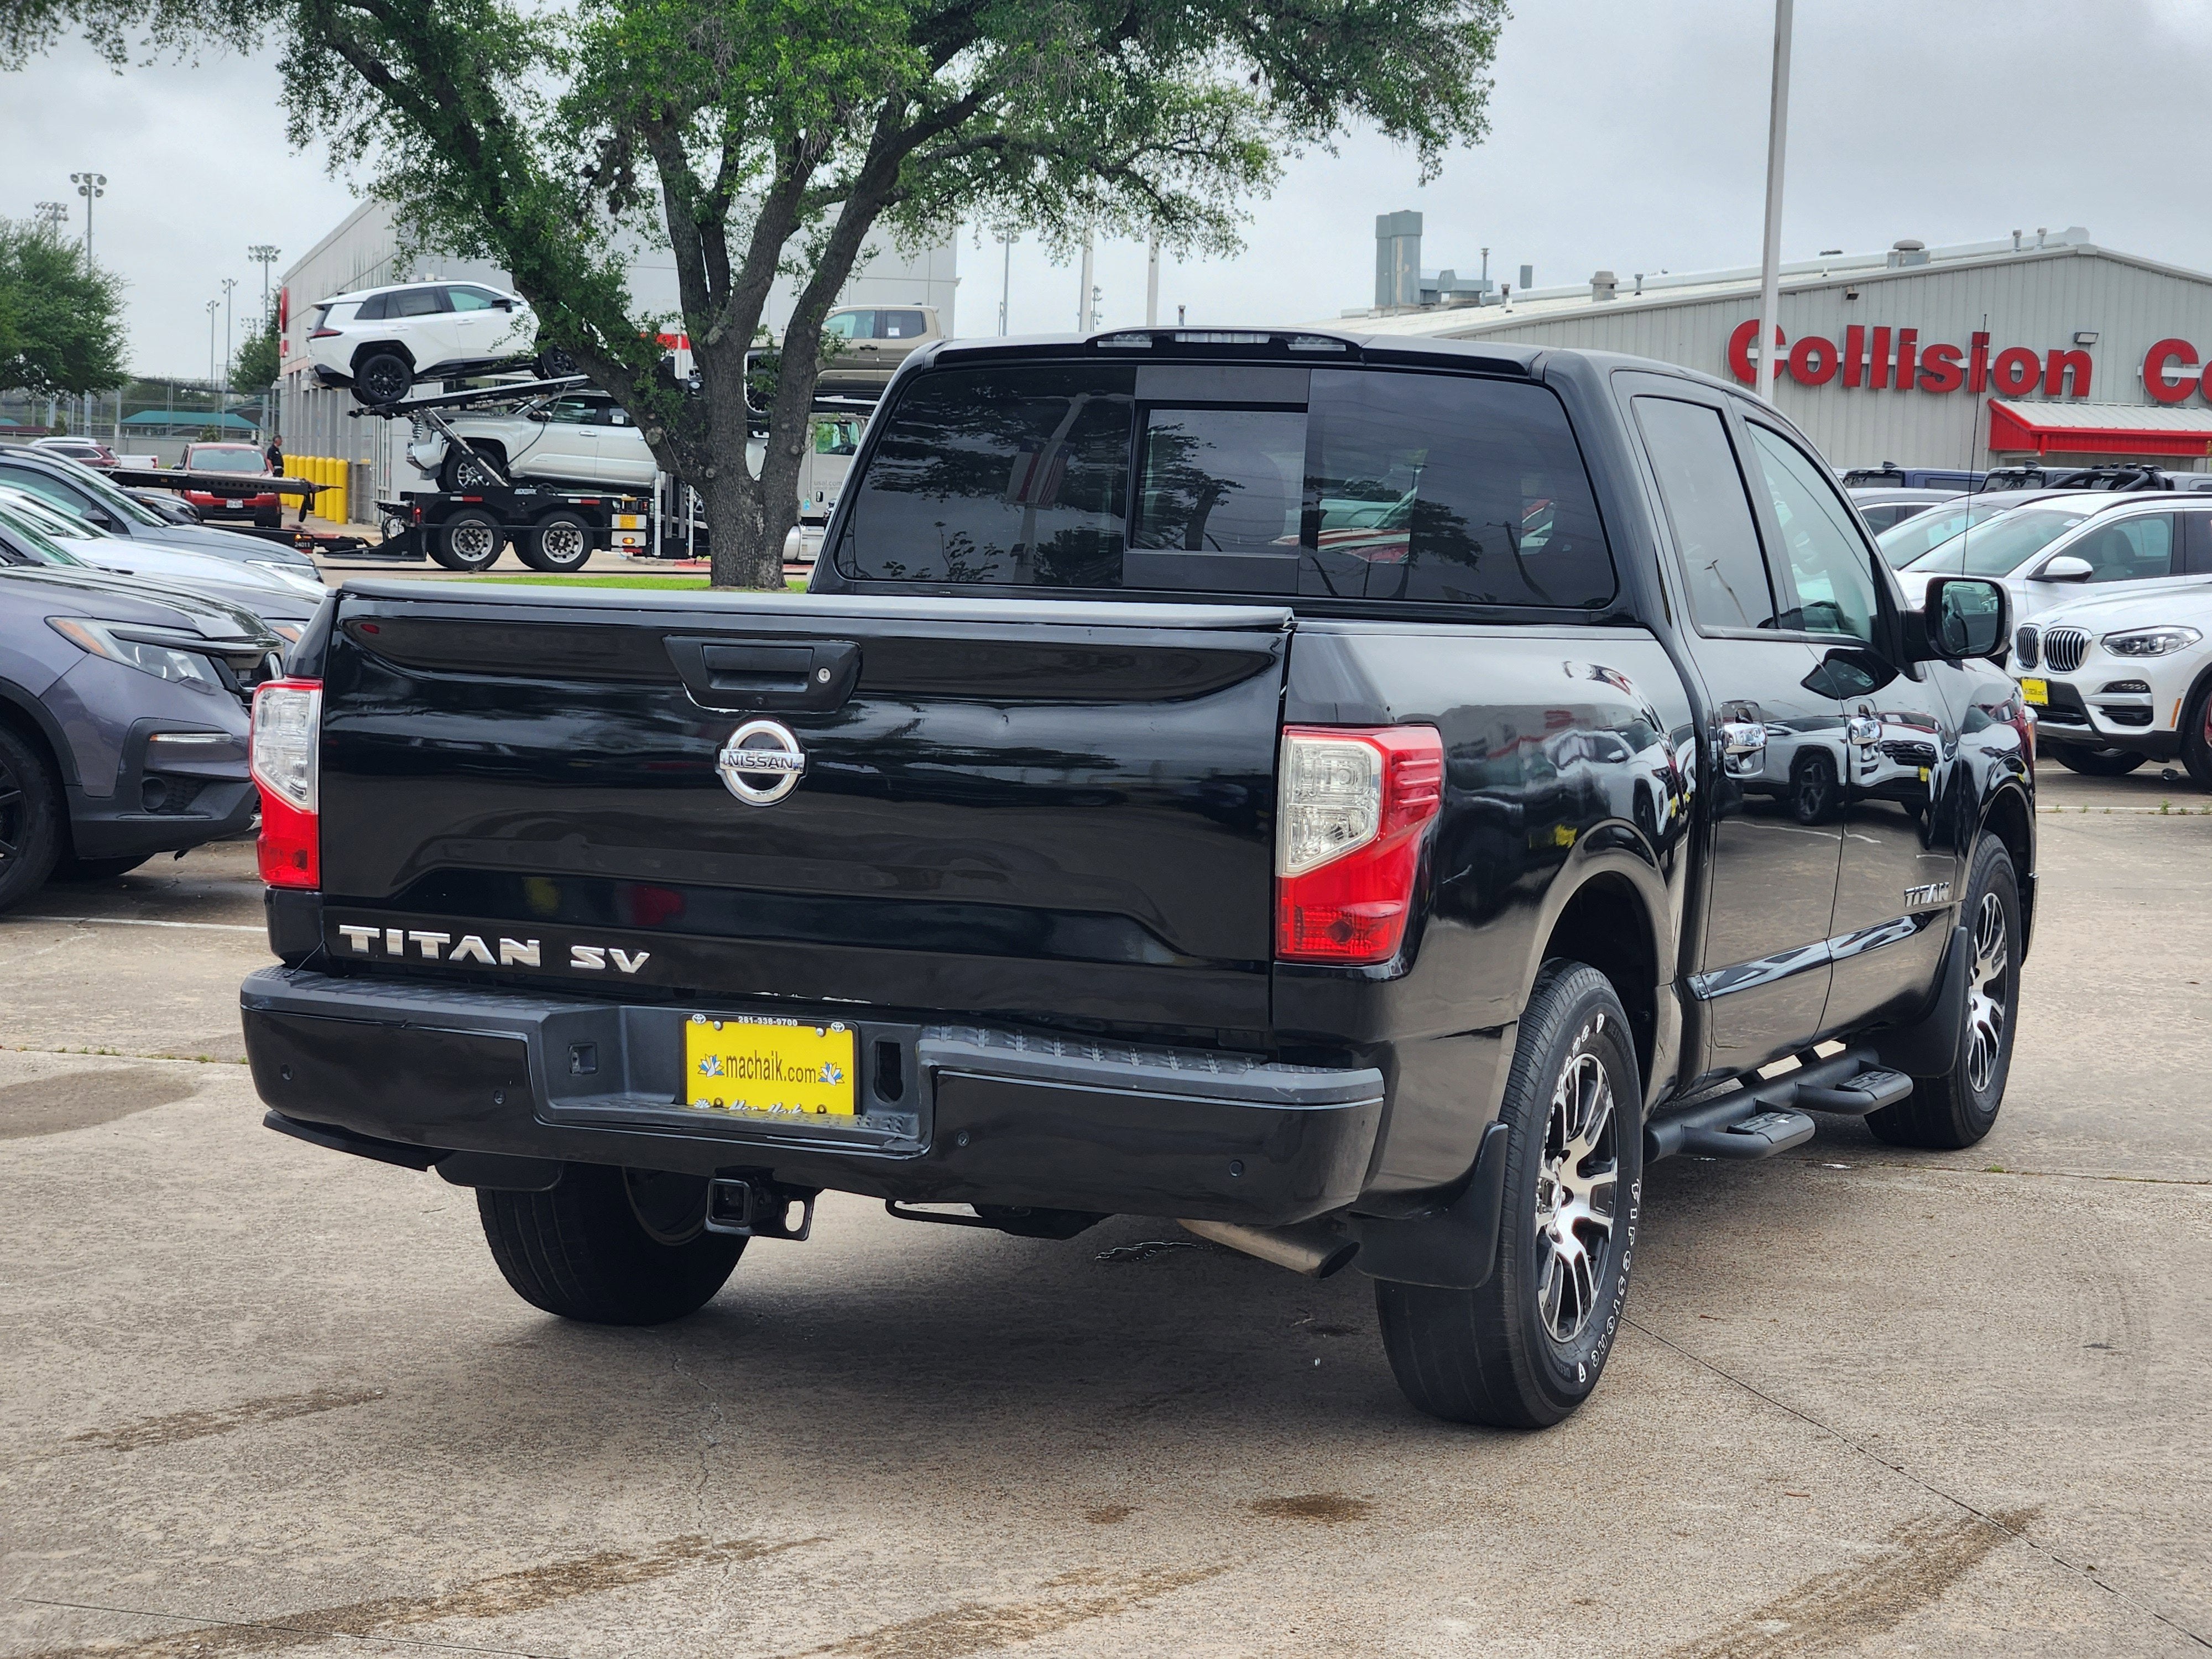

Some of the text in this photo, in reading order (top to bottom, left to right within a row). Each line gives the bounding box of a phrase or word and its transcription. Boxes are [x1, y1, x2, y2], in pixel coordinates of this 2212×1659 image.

[1728, 319, 2212, 404] Collision C
[728, 754, 794, 769] NISSAN
[1905, 882, 1950, 907] TITAN
[339, 925, 651, 974] TITAN SV
[738, 1016, 798, 1026] 281-338-9700
[726, 1050, 816, 1084] machaik.com
[1592, 1178, 1641, 1368] Firestone
